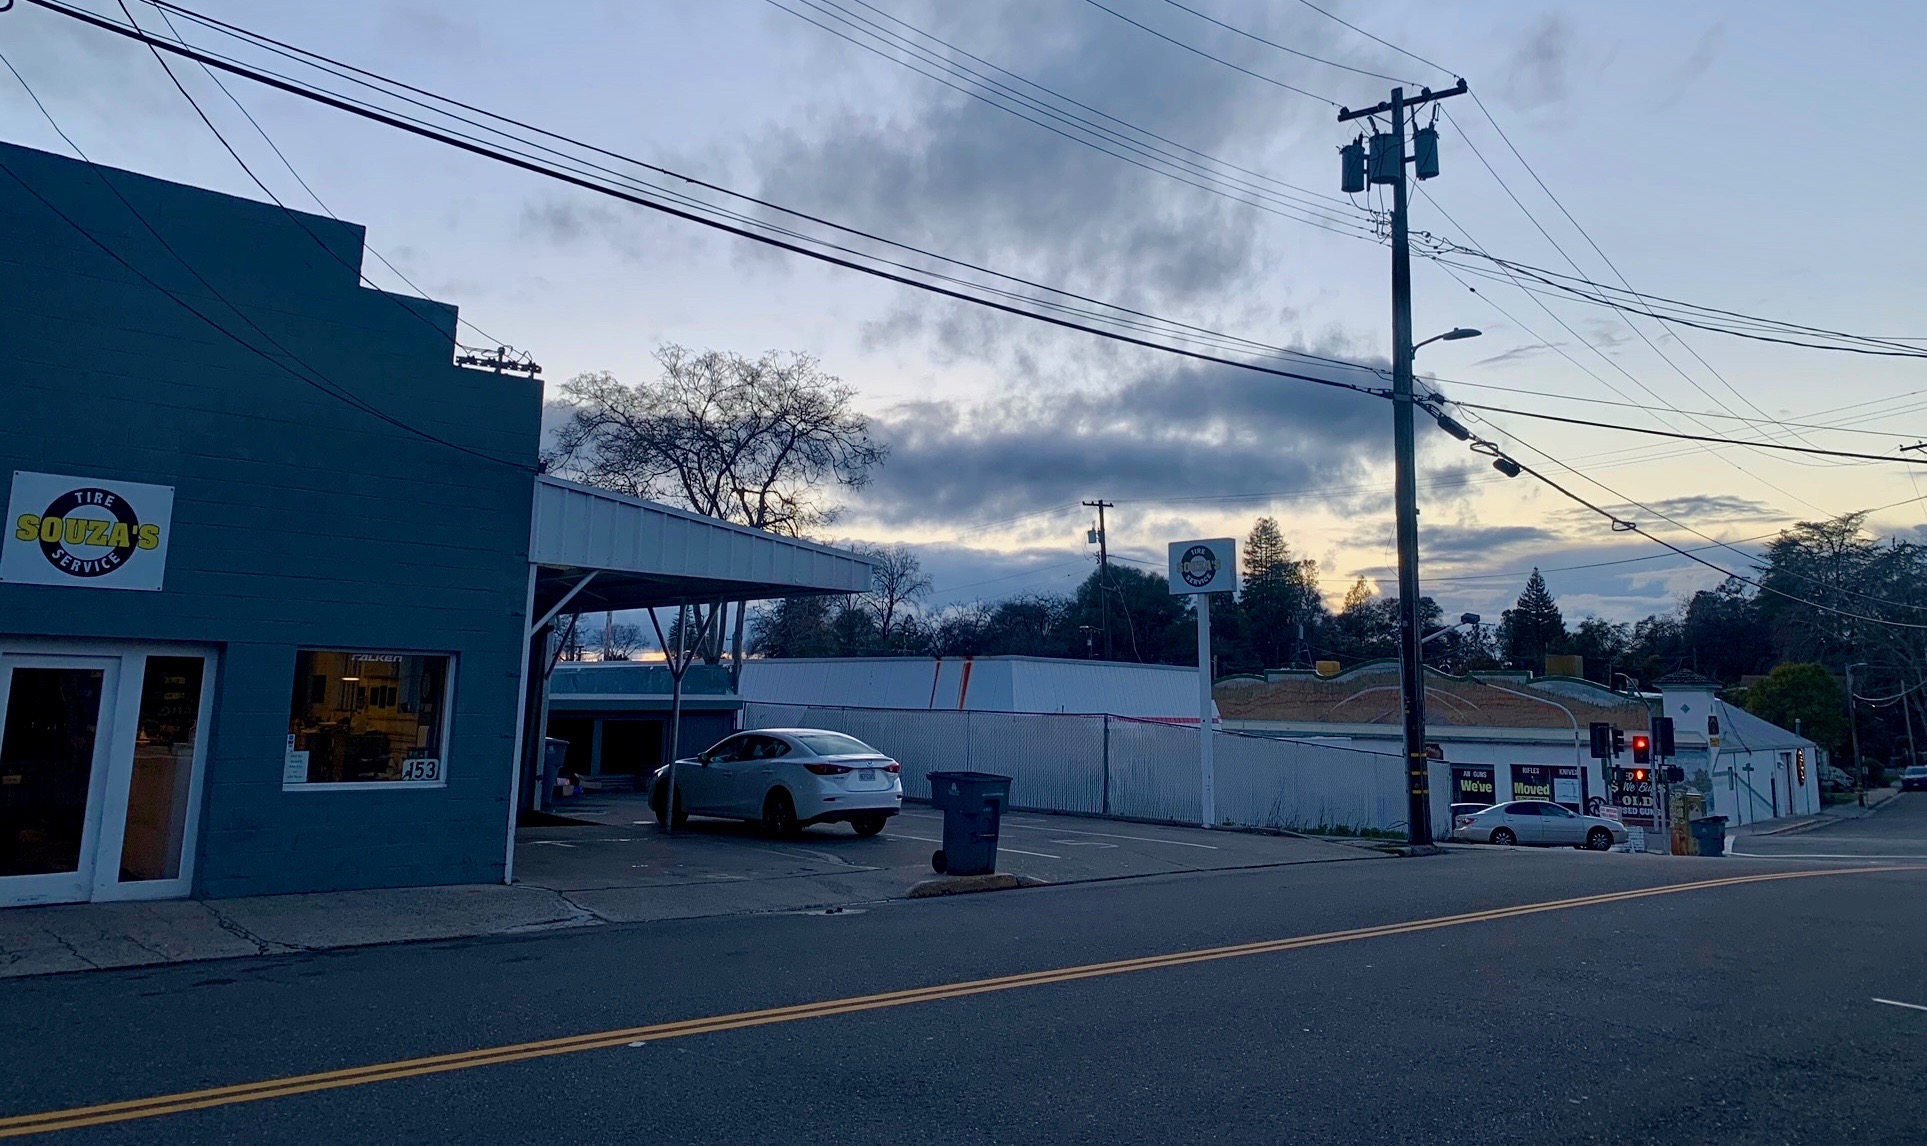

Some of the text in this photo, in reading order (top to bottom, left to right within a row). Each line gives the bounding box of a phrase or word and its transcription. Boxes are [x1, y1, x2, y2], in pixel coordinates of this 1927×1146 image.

[75, 491, 115, 507] TIRE
[15, 513, 160, 550] SOUZA'S
[52, 549, 120, 573] SERVICE
[1186, 573, 1212, 585] SERVICE
[1460, 779, 1493, 793] We've
[1513, 782, 1550, 795] Moved
[1623, 781, 1635, 792] We
[1622, 795, 1653, 807] OLD
